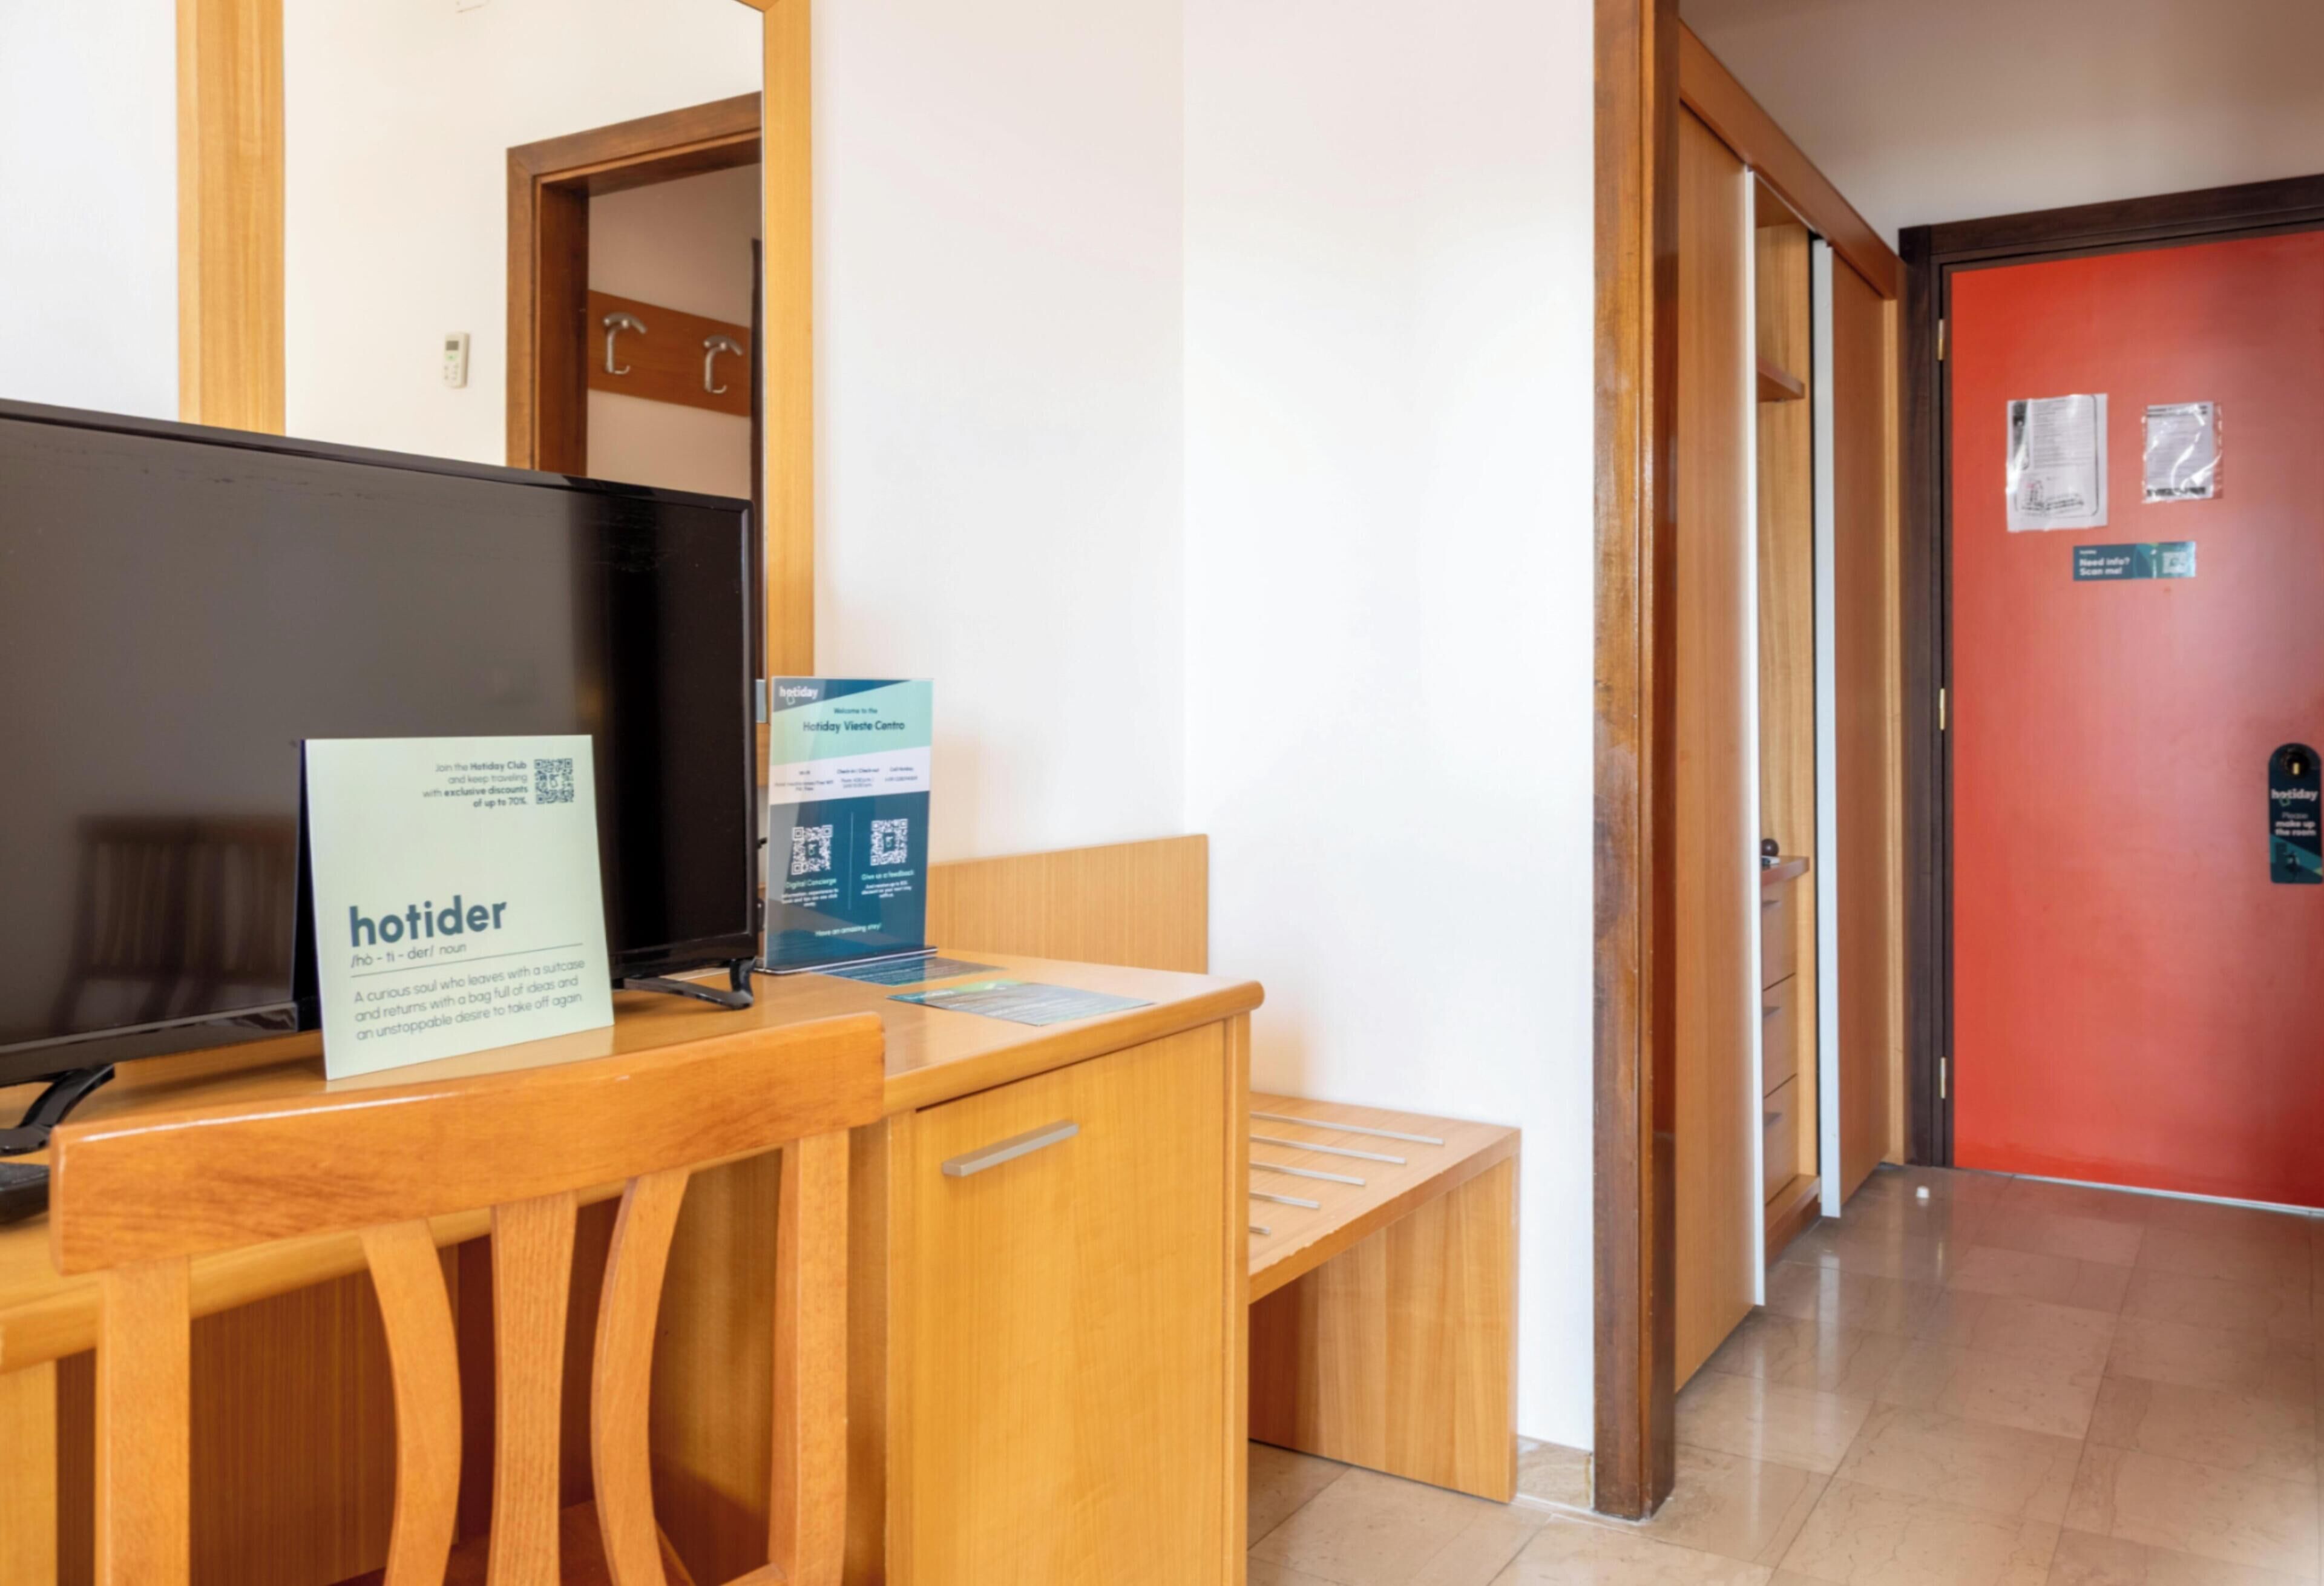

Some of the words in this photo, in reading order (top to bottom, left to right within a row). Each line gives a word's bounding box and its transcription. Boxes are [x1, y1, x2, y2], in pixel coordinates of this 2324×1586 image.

[2079, 558, 2104, 567] Need
[2079, 567, 2104, 576] Scan
[779, 686, 819, 700] hotiday
[803, 721, 841, 734] Hotiday
[844, 721, 873, 731] Vieste
[875, 720, 905, 730] Centro
[435, 763, 453, 772] Join
[454, 763, 468, 771] the
[470, 762, 505, 772] Hotiday
[507, 760, 527, 770] Club
[448, 775, 465, 784] and
[467, 774, 489, 784] keep
[491, 773, 528, 784] traveling
[422, 788, 442, 797] with
[444, 787, 486, 797] exclusive
[488, 785, 528, 795] discounts
[2271, 788, 2319, 802] hotiday
[473, 798, 483, 808] of
[484, 799, 496, 809] up
[497, 798, 507, 806] to
[2303, 821, 2316, 829] up
[2275, 828, 2290, 836] the
[349, 895, 507, 947] hotider
[386, 951, 395, 962] ti
[407, 945, 434, 960] der/
[439, 943, 467, 955] noun
[354, 991, 364, 1003] A
[367, 985, 411, 1002] curious
[414, 979, 437, 995] soul
[440, 976, 465, 990] who
[468, 972, 504, 985] leaves
[508, 966, 531, 979] with
[533, 967, 540, 976] a
[543, 959, 585, 974] suitcase
[355, 1007, 381, 1022] and
[383, 1001, 427, 1017] returns
[430, 996, 455, 1009] with
[458, 996, 466, 1005] a
[468, 992, 491, 1004] bag
[494, 985, 510, 999] full
[512, 983, 524, 996] of
[527, 980, 555, 993] ideas
[557, 975, 579, 989] and
[356, 1028, 374, 1041] an
[376, 1014, 453, 1038] unstoppable
[455, 1010, 490, 1024] desire
[493, 1006, 505, 1016] to
[508, 1001, 533, 1014] take
[534, 995, 549, 1010] off
[551, 993, 582, 1008] again
